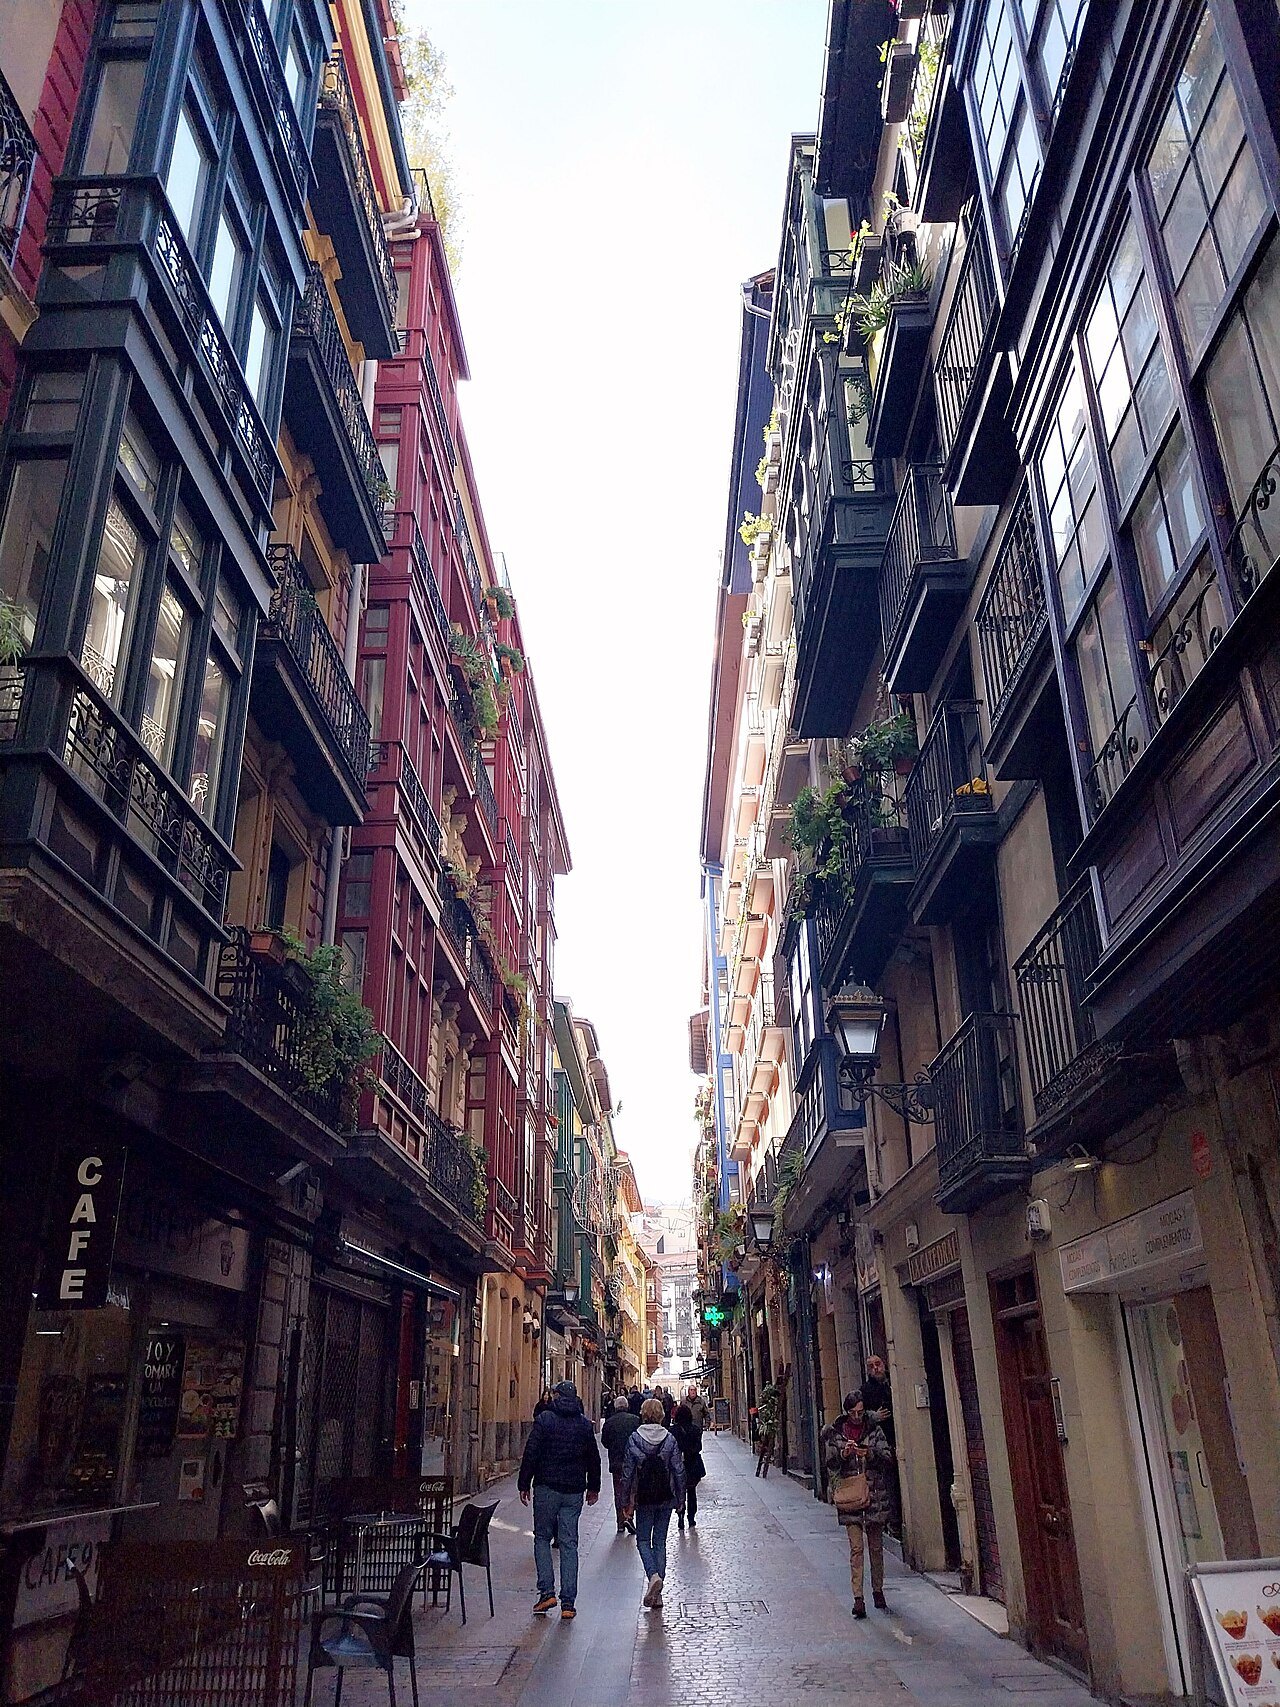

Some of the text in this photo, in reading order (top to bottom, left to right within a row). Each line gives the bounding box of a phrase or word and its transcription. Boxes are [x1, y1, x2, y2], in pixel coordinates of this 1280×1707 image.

[59, 1156, 103, 1300] CAFE
[144, 1359, 179, 1380] OMARÉ
[247, 1548, 292, 1567] Coca-Cola
